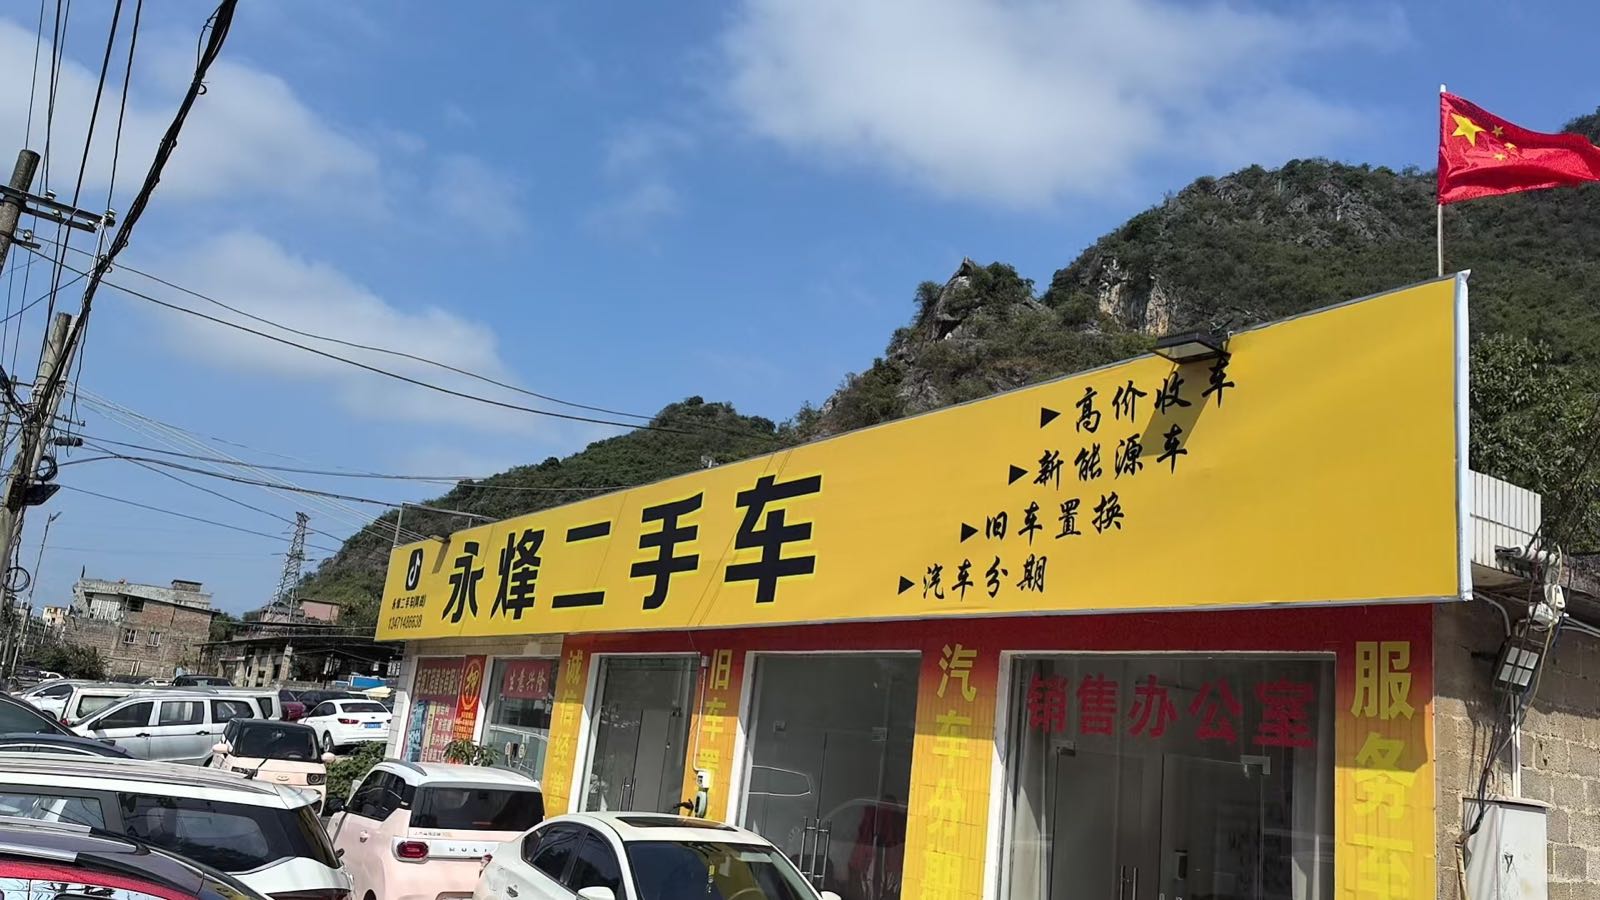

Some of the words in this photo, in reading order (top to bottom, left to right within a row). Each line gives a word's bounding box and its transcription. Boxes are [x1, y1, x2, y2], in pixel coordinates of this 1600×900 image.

[1075, 358, 1235, 434] 高价收车
[1033, 424, 1188, 491] 新能源车
[442, 475, 822, 623] 永烽二手车
[984, 491, 1125, 546] 旧车置换
[922, 554, 1048, 602] 汽车分期
[509, 667, 546, 693] 生意兴隆
[1027, 672, 1316, 749] 销售办公室
[551, 649, 584, 808] 诚信经营
